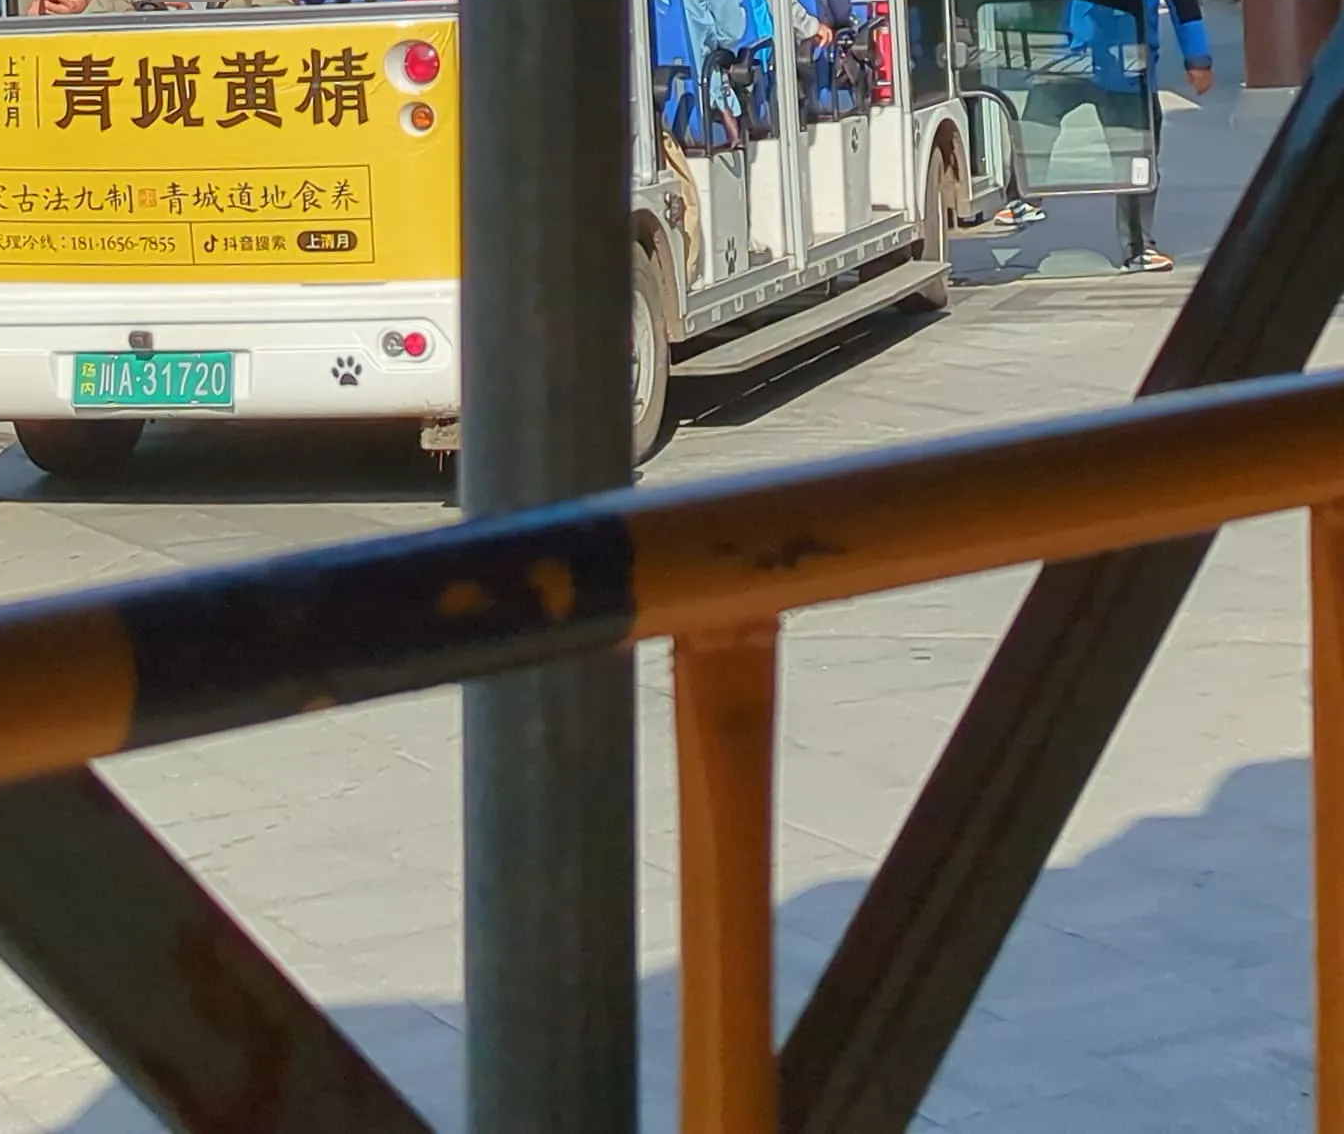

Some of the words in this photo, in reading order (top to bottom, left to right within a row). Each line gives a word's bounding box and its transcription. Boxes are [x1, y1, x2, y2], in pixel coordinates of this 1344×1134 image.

[3, 56, 21, 128] 上清月
[52, 47, 376, 132] 青城黄精
[159, 179, 360, 215] 青城道地食养
[306, 233, 349, 250] 上清月
